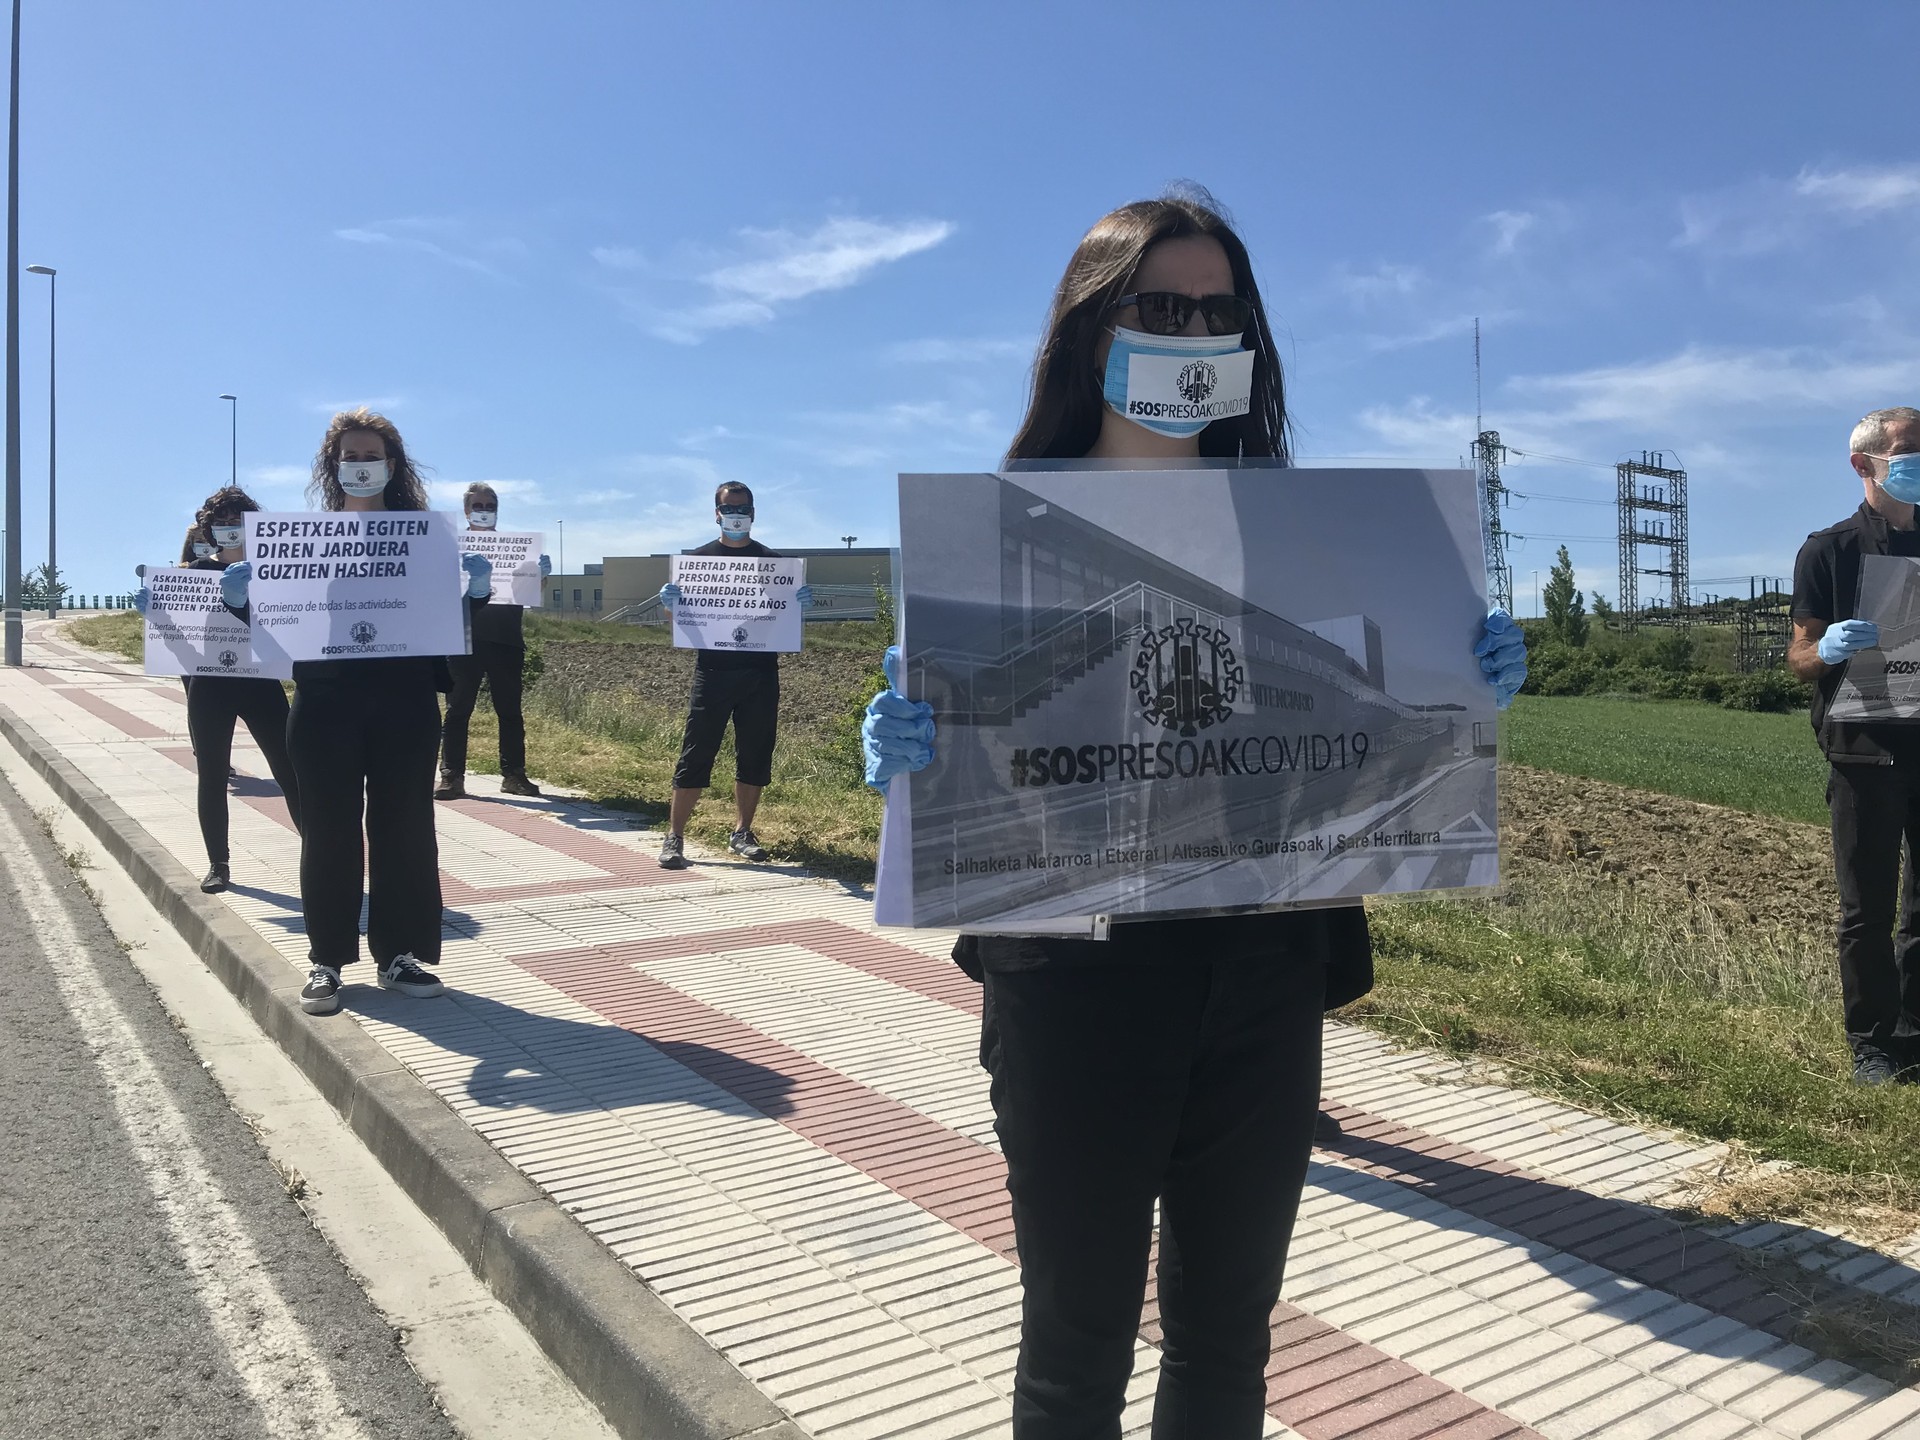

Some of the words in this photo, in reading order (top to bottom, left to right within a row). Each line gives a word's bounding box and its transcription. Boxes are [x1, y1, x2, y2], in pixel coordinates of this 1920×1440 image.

[1129, 397, 1248, 418] #SOSPRESOAKCOVID19
[256, 521, 360, 537] ESPETXEAN
[366, 520, 429, 536] EGITEN
[499, 537, 532, 545] MUJERES
[256, 542, 314, 559] DIREN
[320, 541, 410, 557] JARDUERA
[257, 563, 330, 580] GUZTIEN
[334, 562, 407, 578] HASIERA
[679, 561, 726, 571] LIBERTAD
[729, 562, 755, 572] PARA
[758, 563, 776, 573] LAS
[678, 573, 731, 583] PERSONAS
[733, 574, 770, 585] PRESAS
[773, 576, 794, 585] CON
[152, 584, 201, 594] LABURRAK
[679, 585, 756, 596] ENFERMEDADES
[759, 588, 766, 597] Y
[152, 593, 209, 603] DAGOENEKO
[678, 597, 725, 607] MAYORES
[728, 599, 741, 608] DE
[744, 600, 757, 609] 65
[759, 598, 787, 609] AÑOS
[152, 602, 196, 612] DITUZTEN
[258, 602, 302, 613] Comienzo
[305, 600, 317, 612] de
[318, 600, 342, 611] todas
[344, 599, 357, 610] las
[358, 598, 407, 610] actividades
[258, 618, 269, 626] en
[271, 615, 299, 627] prisión
[149, 622, 176, 631] Libertad
[177, 625, 207, 633] personas
[208, 626, 230, 634] presas
[149, 633, 163, 641] que
[163, 632, 184, 642] hayan
[184, 633, 218, 641] disfrutado
[219, 635, 228, 643] ya
[228, 634, 237, 642] de
[321, 643, 407, 655] #SOSPRESOAKCOVID19
[1010, 732, 1369, 788] #SOSPRESOAKCOVID19
[944, 855, 1021, 875] Salhaketa
[1027, 849, 1092, 869] Nafarroa
[1105, 847, 1160, 864] Etxerat
[1172, 841, 1248, 860] Altsasuko
[1252, 835, 1324, 855] Gurasoak
[1336, 832, 1369, 850] Sare
[1374, 830, 1441, 847] Herritarra
